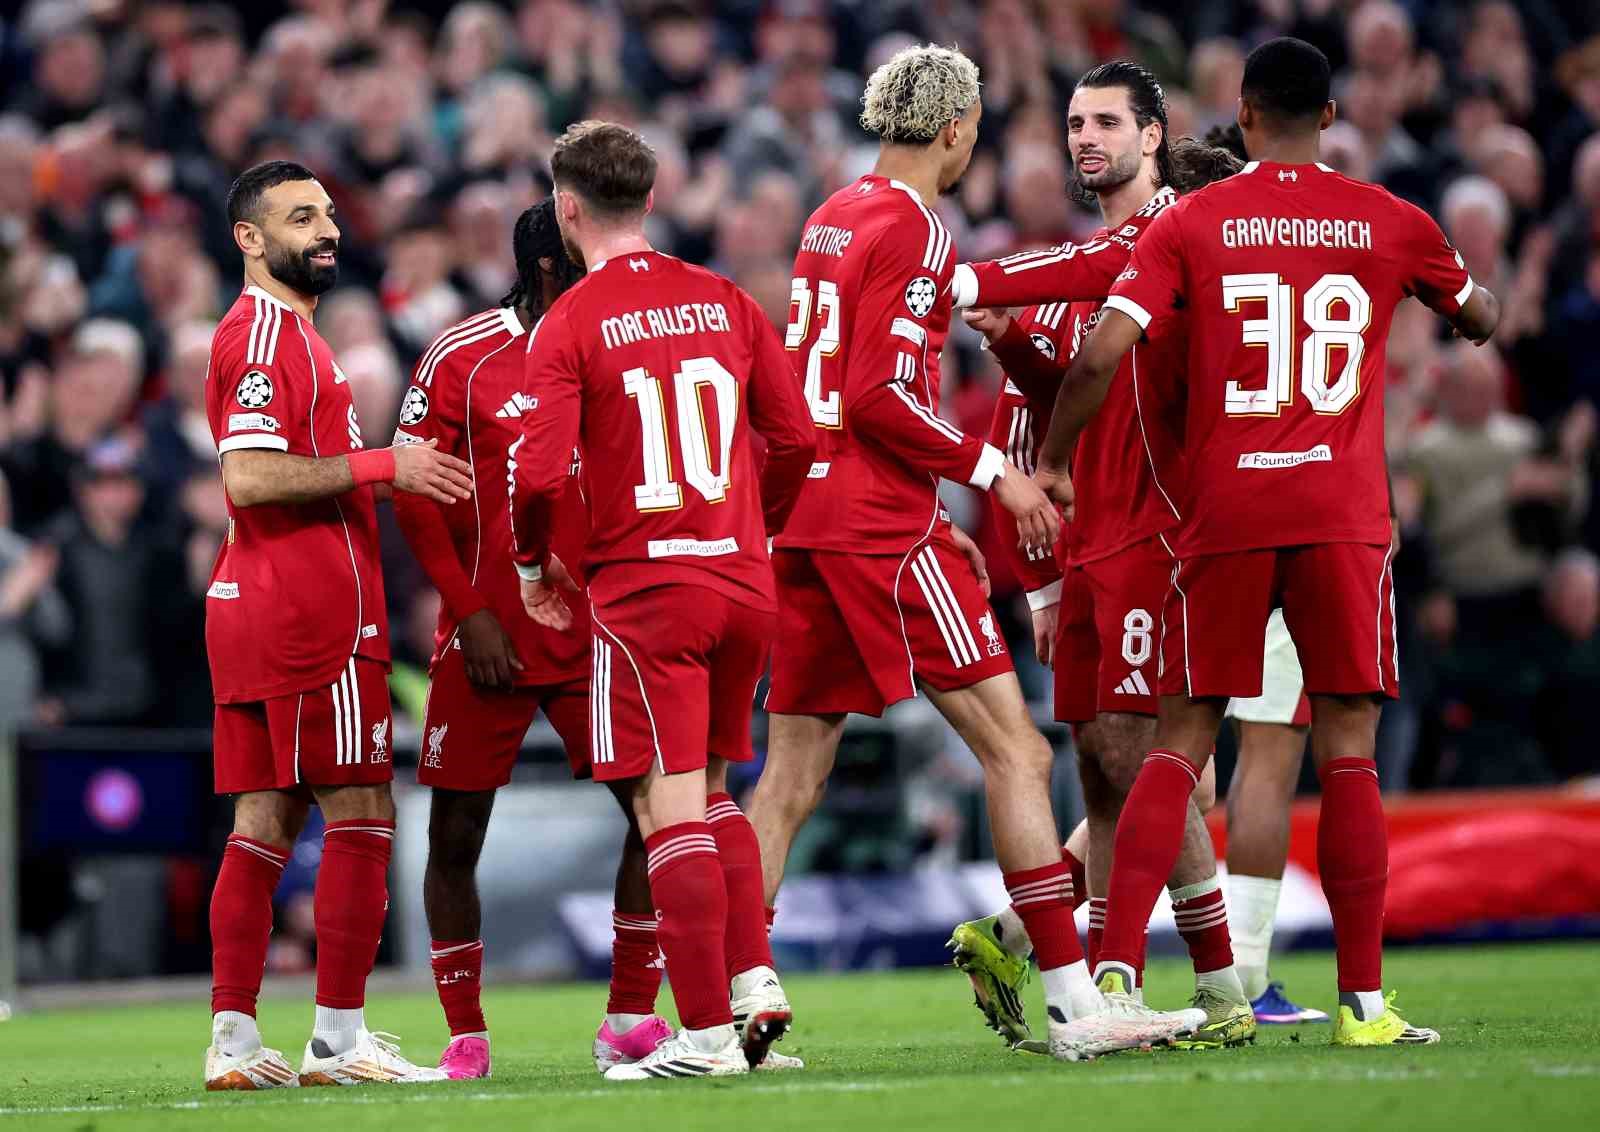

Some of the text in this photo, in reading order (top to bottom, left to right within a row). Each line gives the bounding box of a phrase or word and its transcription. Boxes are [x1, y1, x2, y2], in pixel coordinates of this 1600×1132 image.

[1222, 216, 1372, 250] GRAVENBERCH
[600, 302, 731, 350] MAC ALLISTER
[1221, 272, 1373, 417] 38
[621, 356, 739, 513] 10
[1253, 448, 1328, 466] Foundation
[1121, 608, 1153, 667] 8
